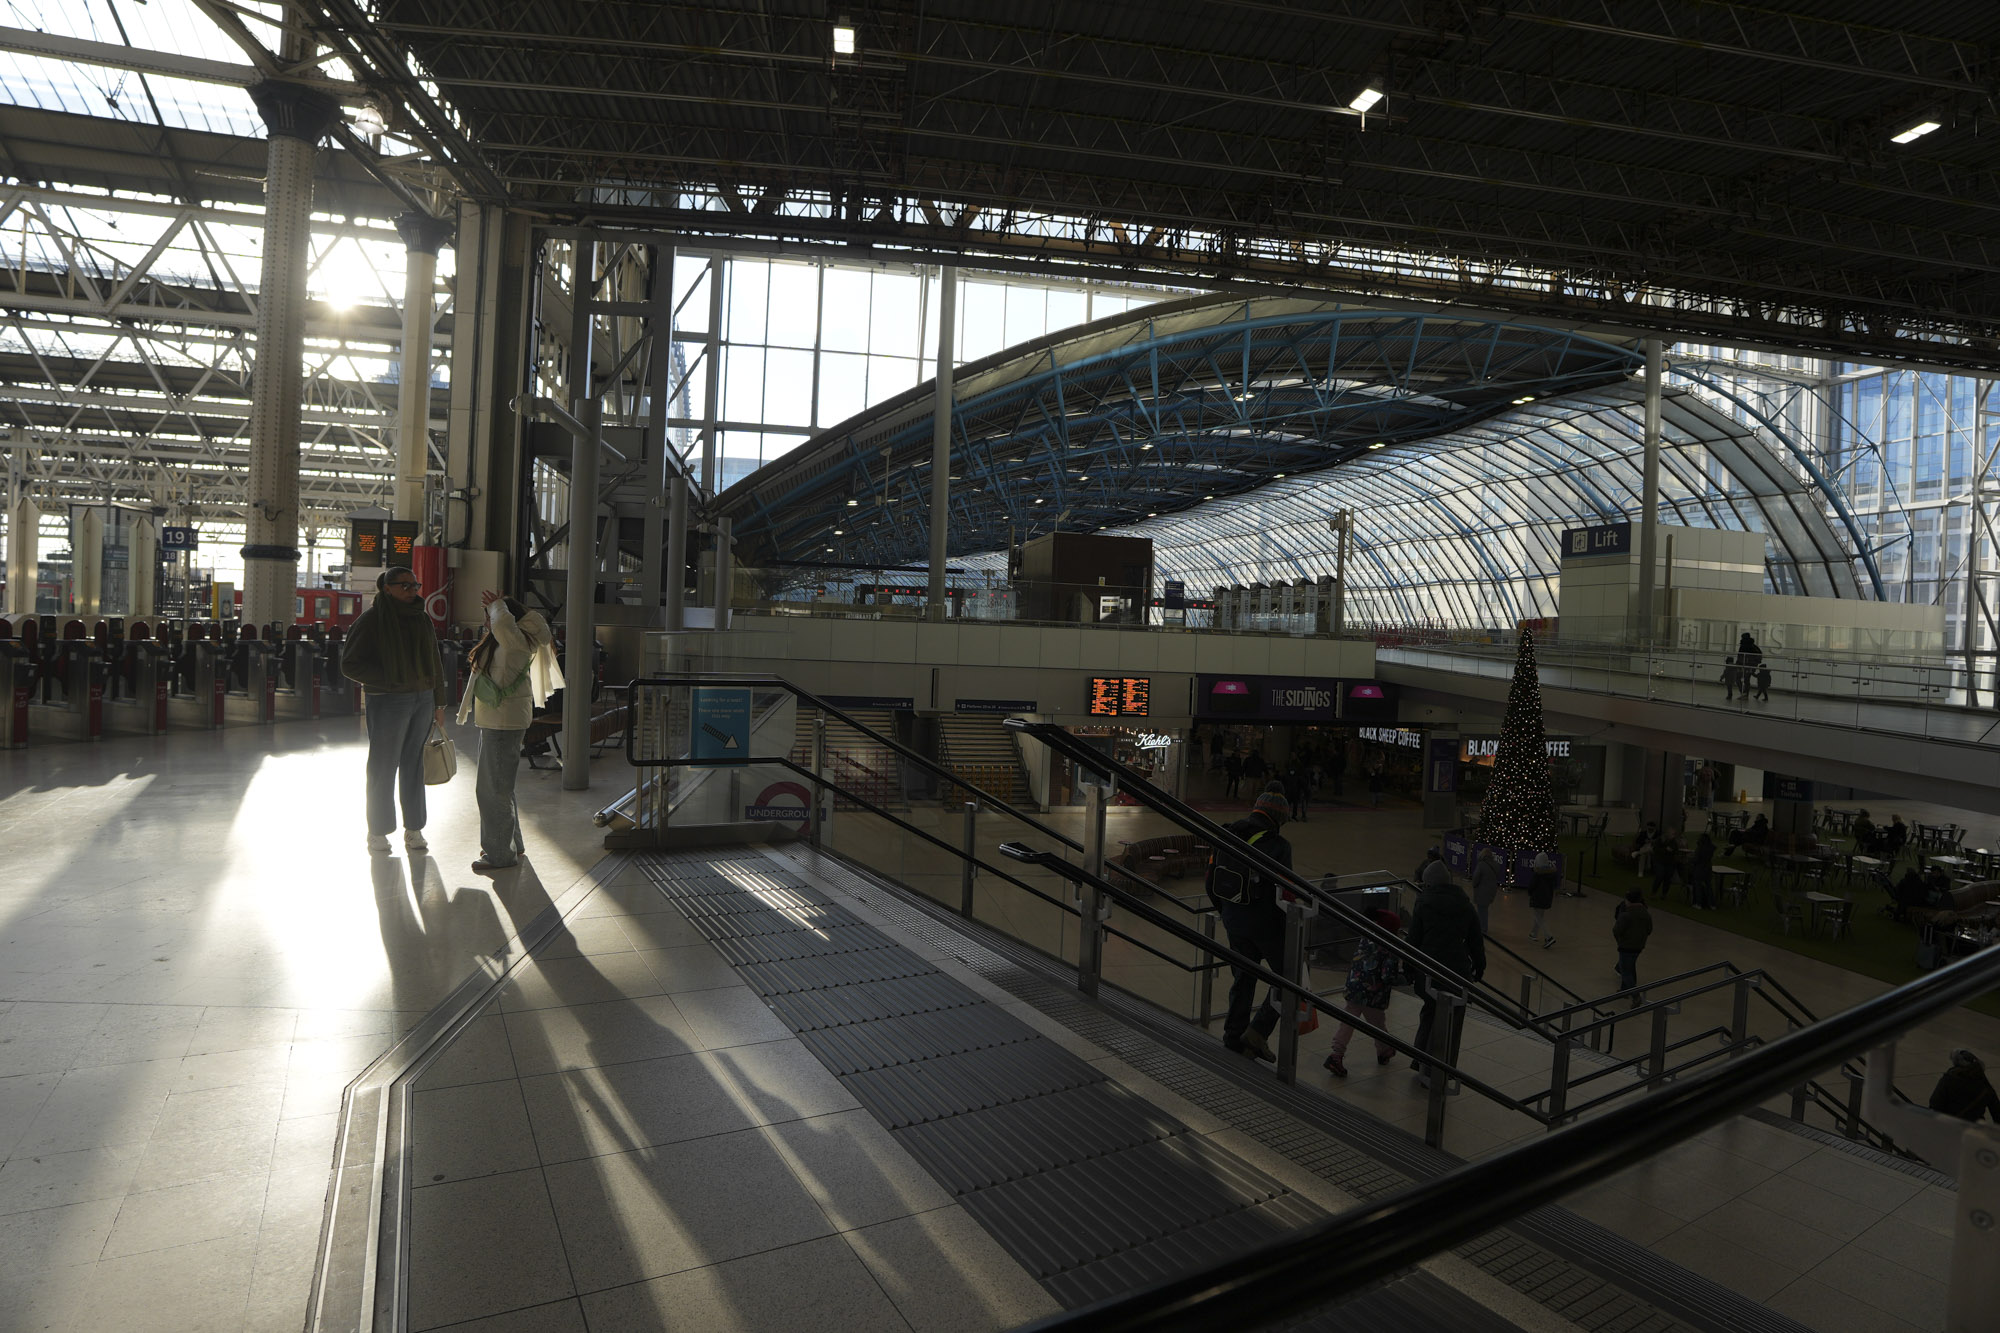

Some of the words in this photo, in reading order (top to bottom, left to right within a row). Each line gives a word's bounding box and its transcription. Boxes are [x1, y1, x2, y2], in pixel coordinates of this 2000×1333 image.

[165, 531, 185, 544] 19
[188, 532, 198, 545] 19
[1595, 530, 1618, 548] Lift
[165, 552, 176, 560] 18
[1272, 689, 1285, 706] THE
[1285, 688, 1331, 708] SIDINGS
[1134, 733, 1171, 747] Kiehl's
[1359, 727, 1377, 741] BLACK
[1378, 728, 1397, 744] SHEEP
[1397, 731, 1421, 749] COFFEE
[1468, 739, 1499, 756] BLACK
[749, 809, 823, 818] UNDERGROU
